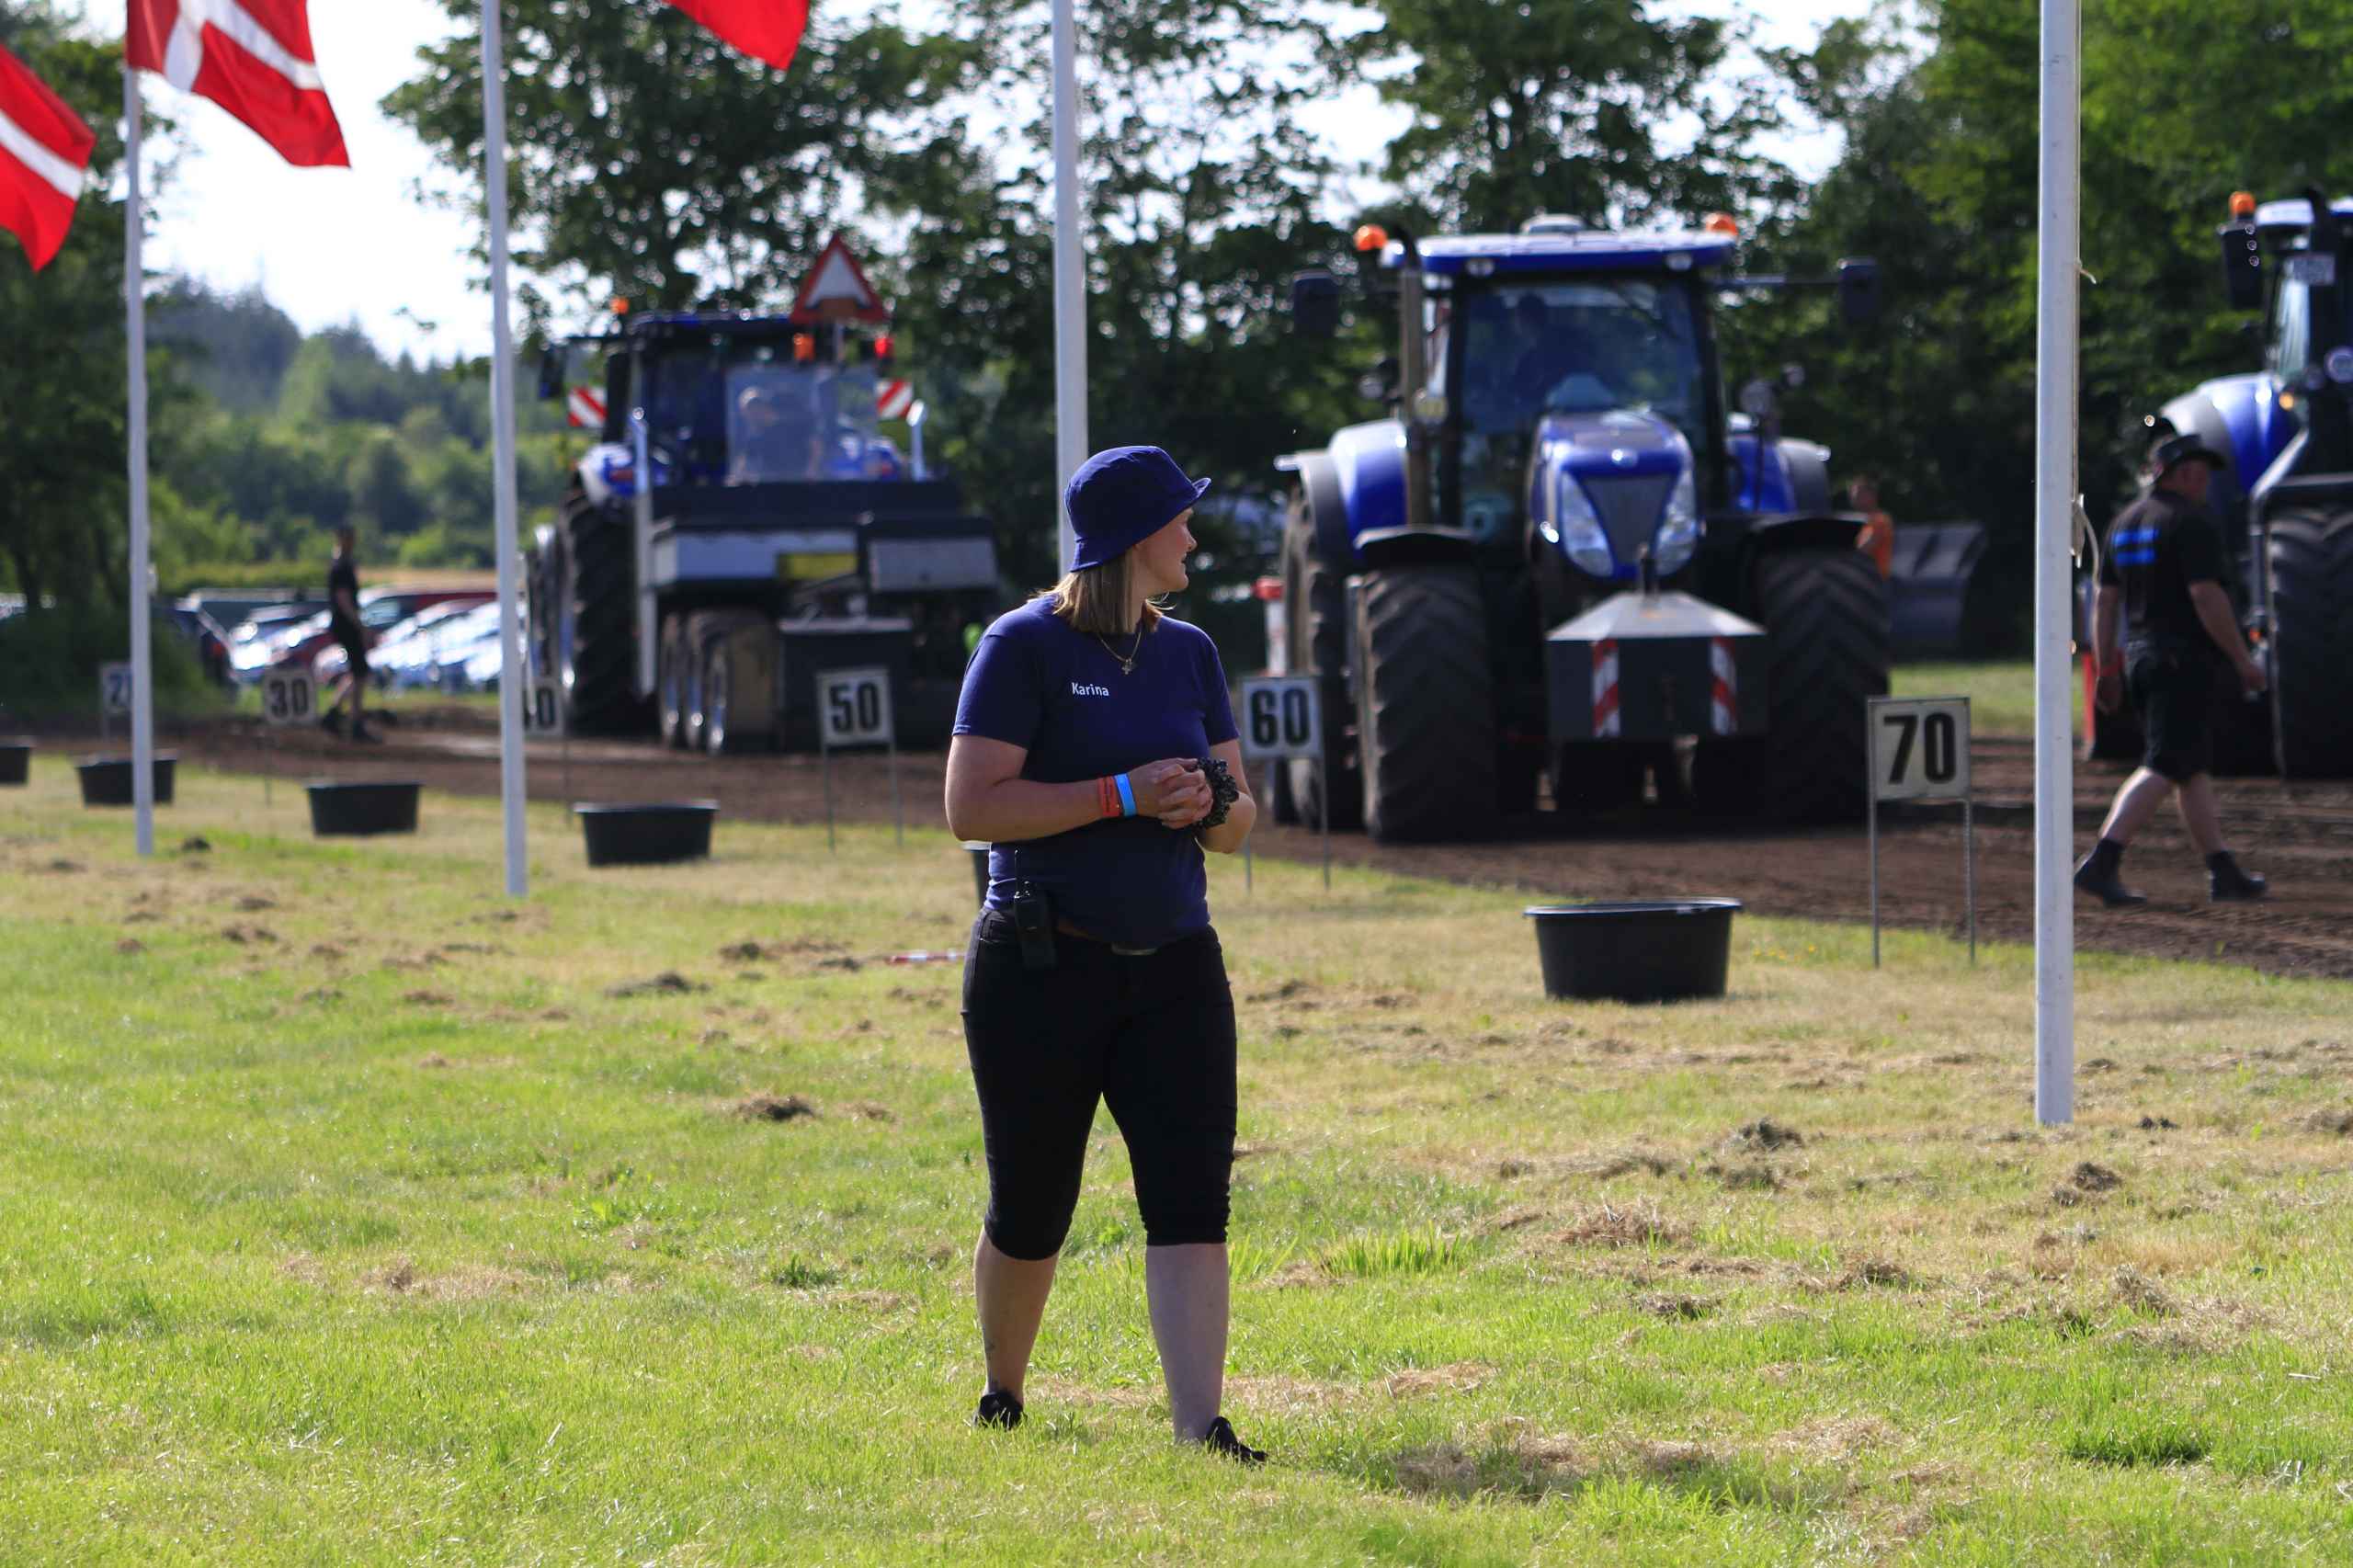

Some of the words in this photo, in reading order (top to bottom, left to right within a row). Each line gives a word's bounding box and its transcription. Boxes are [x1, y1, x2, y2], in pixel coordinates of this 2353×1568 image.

[269, 678, 309, 717] 30
[830, 683, 880, 733] 50
[1071, 681, 1109, 697] Karina
[1251, 688, 1310, 748] 60
[1883, 711, 1956, 785] 70
